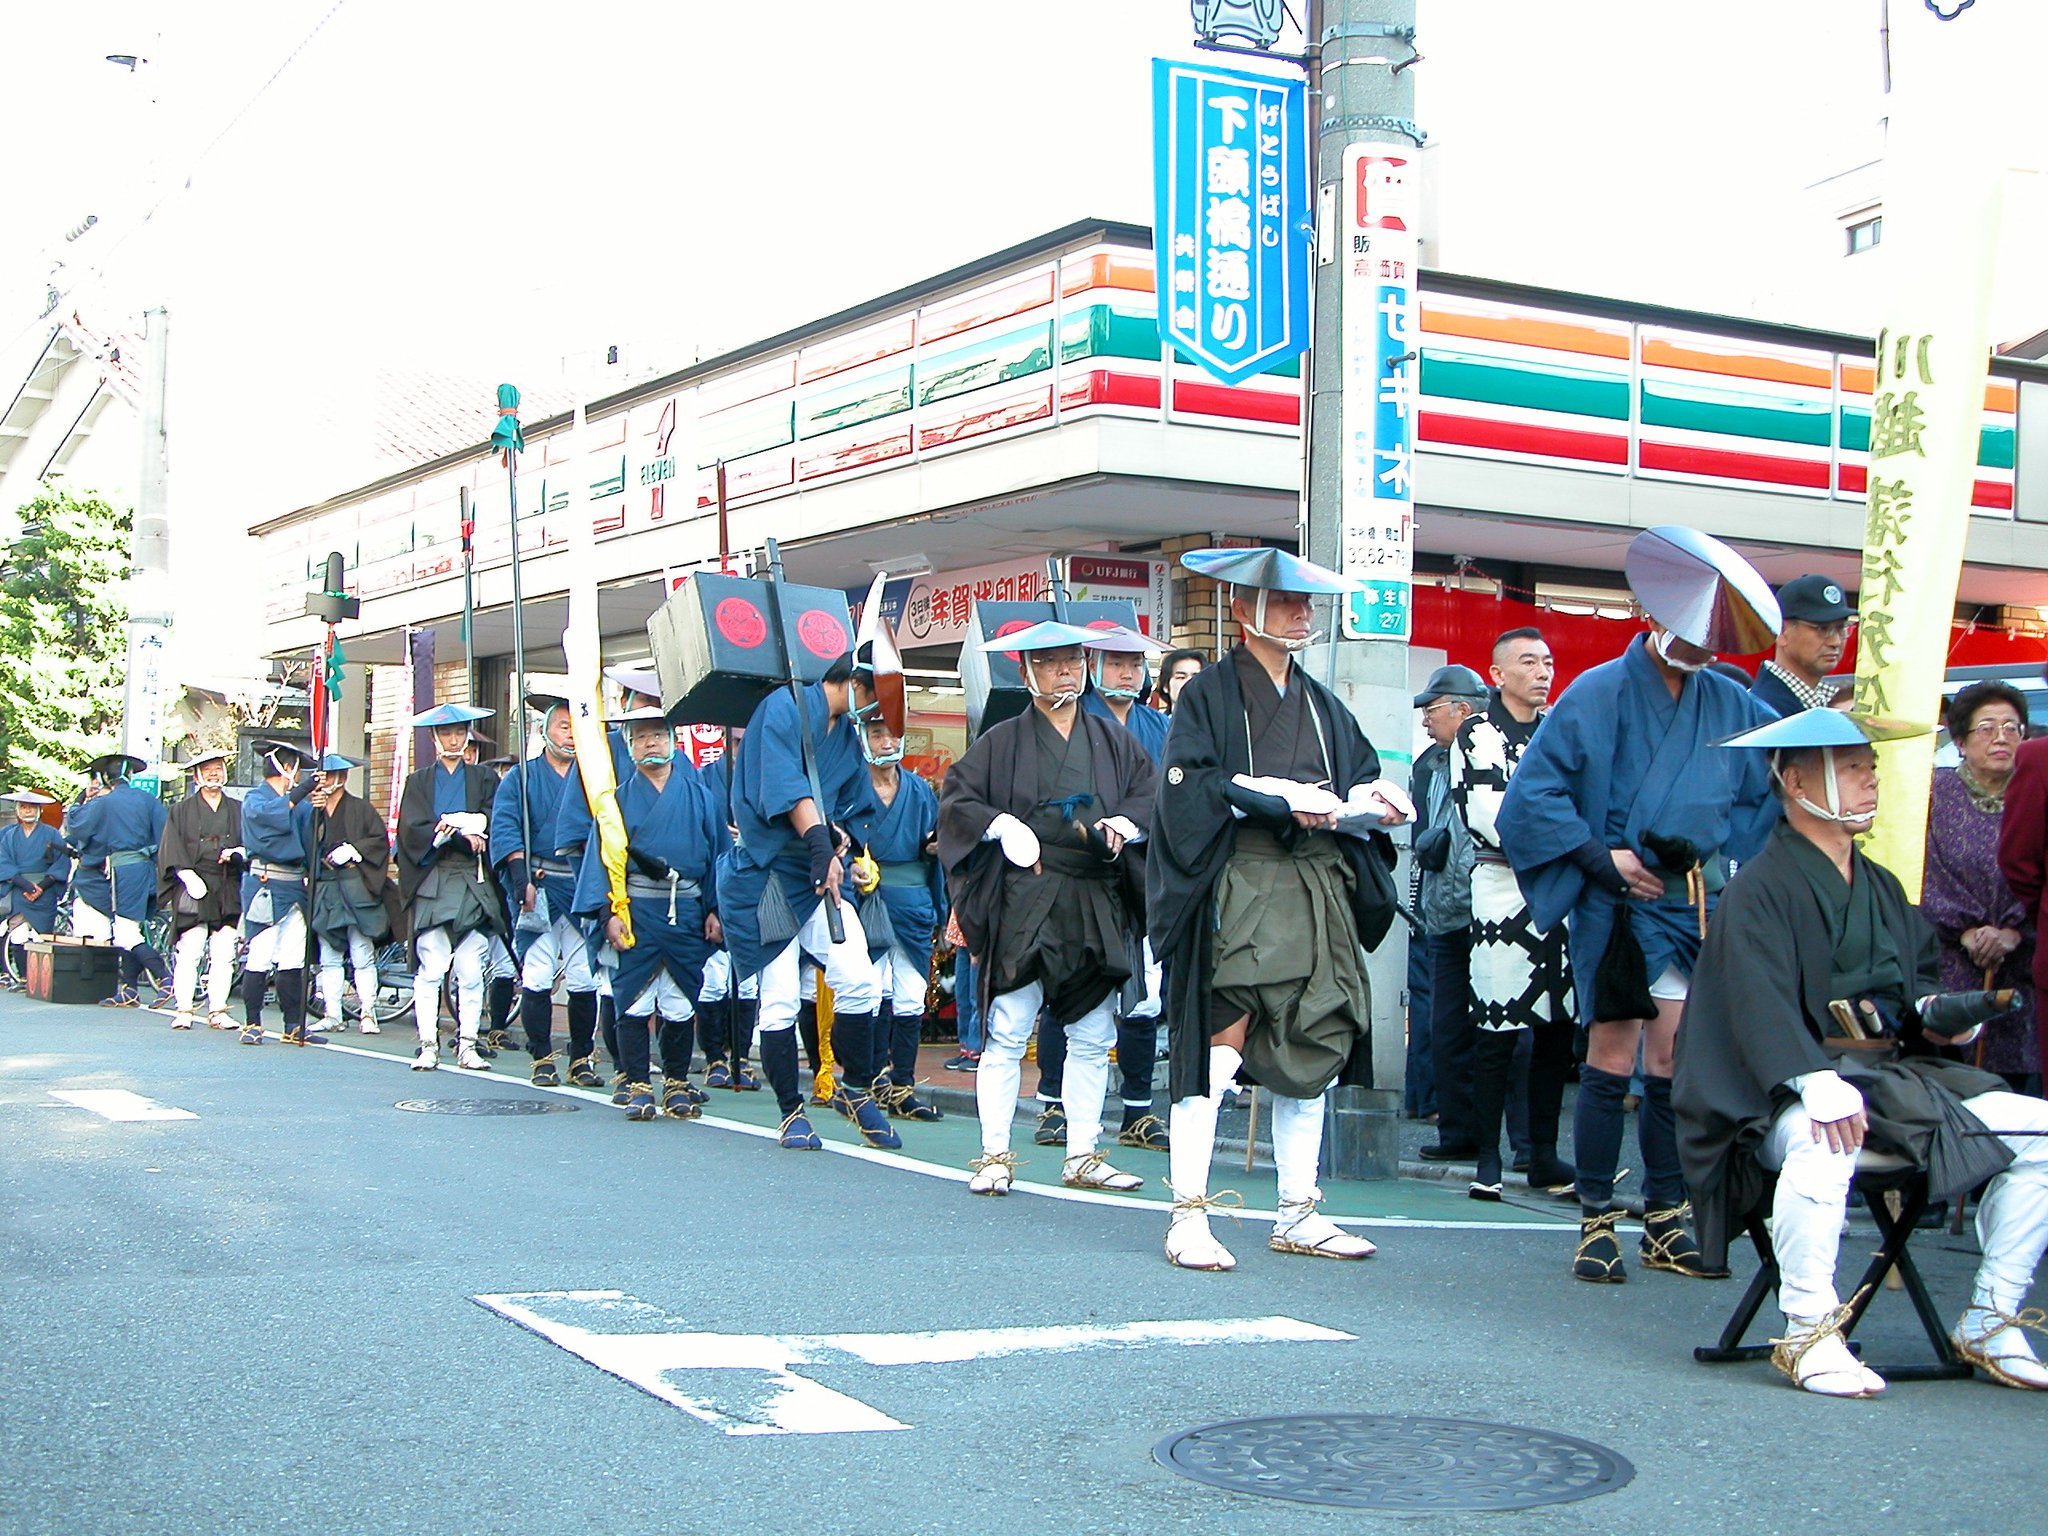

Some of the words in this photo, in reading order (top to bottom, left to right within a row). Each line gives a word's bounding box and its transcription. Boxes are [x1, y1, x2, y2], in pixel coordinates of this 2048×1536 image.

[1206, 95, 1251, 350] 下頭橋通り
[1261, 104, 1281, 247] げとうばし
[1378, 292, 1411, 495] セキネ
[931, 571, 1040, 629] 年賀状印刷
[1096, 566, 1138, 579] UFJ銀行
[1378, 611, 1402, 629] 27
